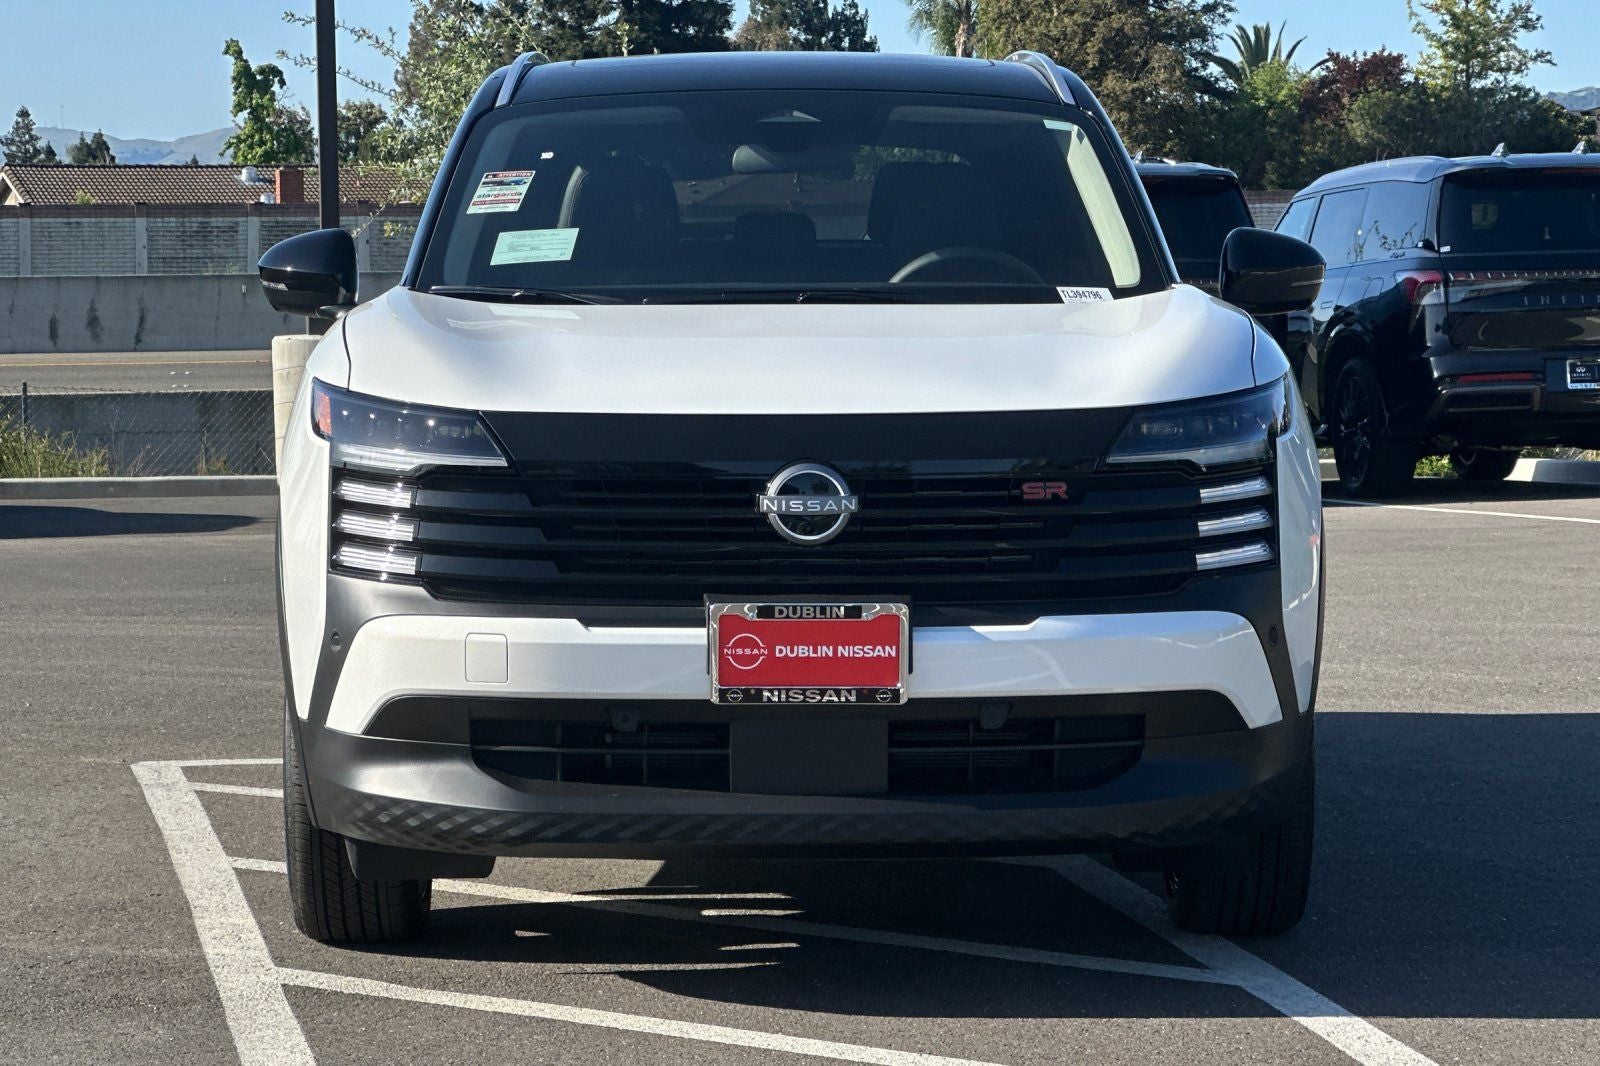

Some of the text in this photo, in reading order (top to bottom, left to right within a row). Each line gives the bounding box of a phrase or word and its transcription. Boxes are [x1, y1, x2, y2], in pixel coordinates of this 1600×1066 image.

[1060, 290, 1102, 299] TL394796
[1022, 481, 1069, 500] SR
[763, 498, 856, 512] NISSAN
[774, 606, 844, 619] DUBLIN
[775, 645, 897, 658] DUBLIN NISSAN
[762, 689, 856, 702] NISSAN
